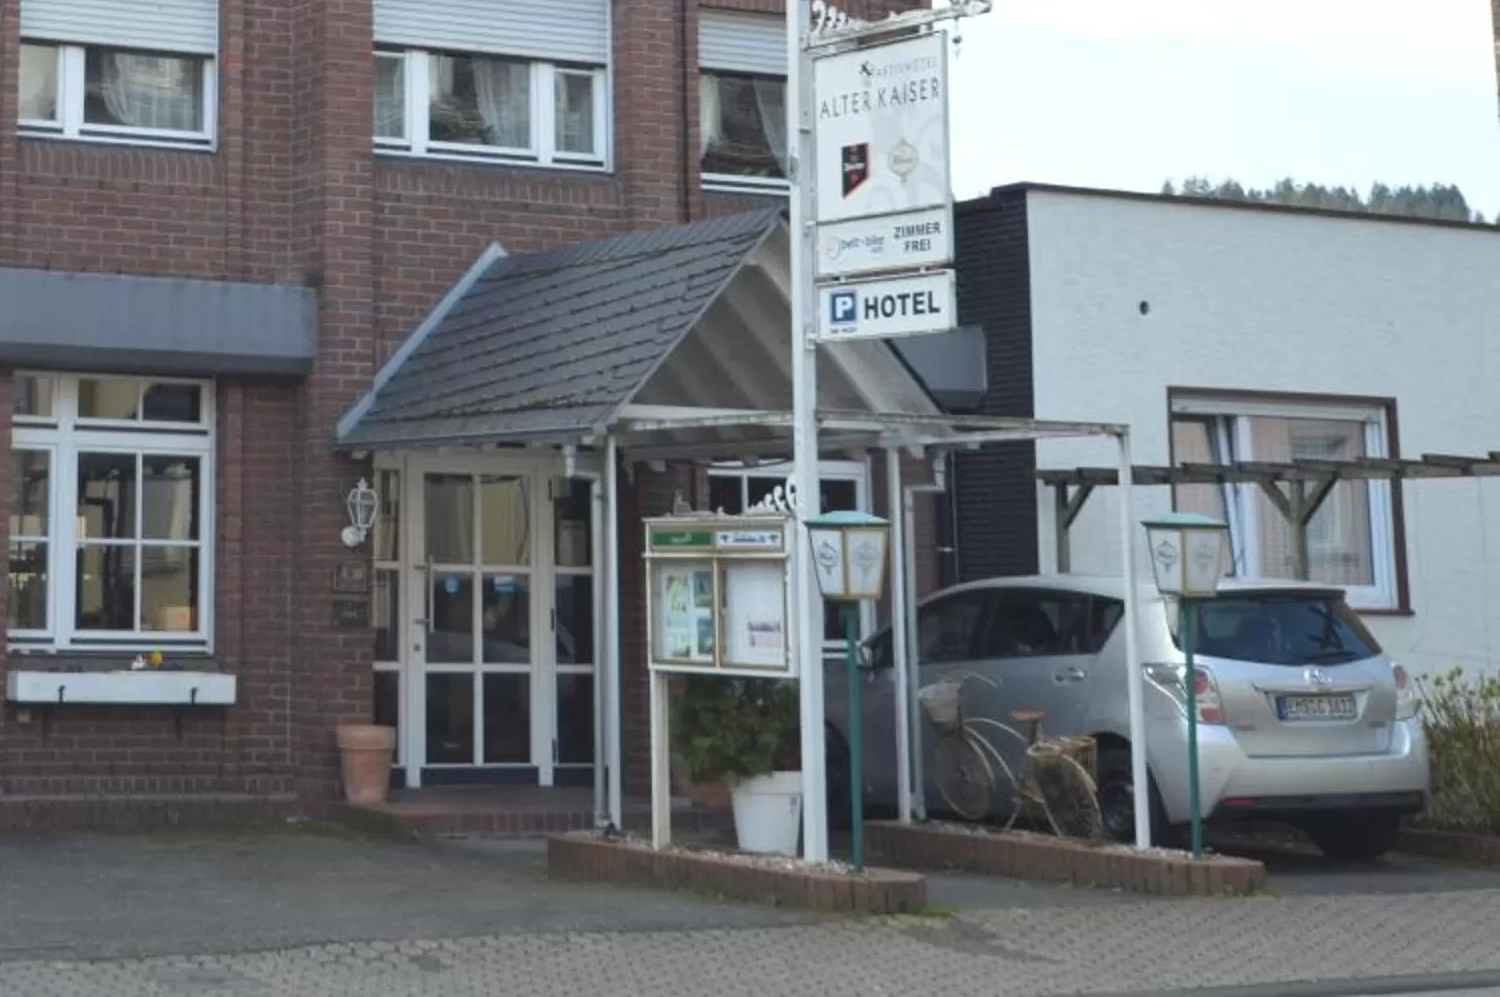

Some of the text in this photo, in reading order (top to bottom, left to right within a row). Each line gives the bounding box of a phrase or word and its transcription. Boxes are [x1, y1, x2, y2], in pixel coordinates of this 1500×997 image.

[819, 76, 940, 119] ALTER KAISER
[893, 221, 941, 240] ZIMMER
[903, 237, 932, 253] FREI
[834, 289, 941, 320] P HOTEL
